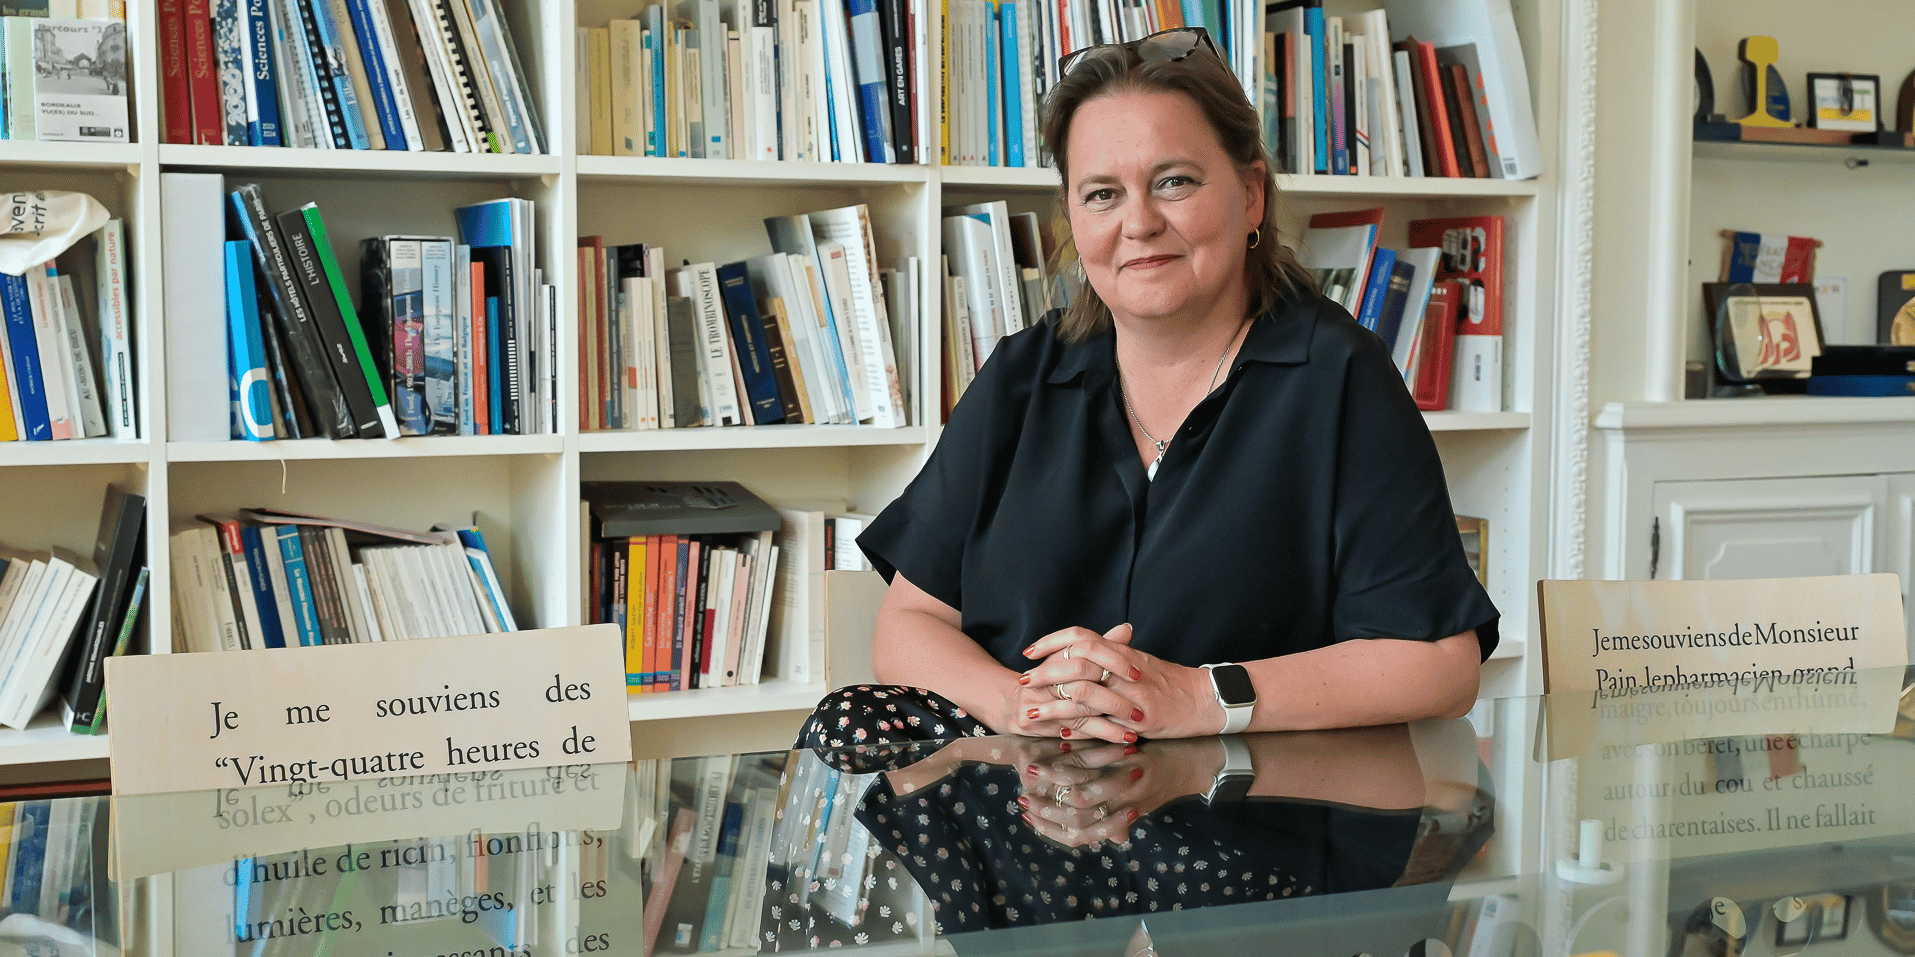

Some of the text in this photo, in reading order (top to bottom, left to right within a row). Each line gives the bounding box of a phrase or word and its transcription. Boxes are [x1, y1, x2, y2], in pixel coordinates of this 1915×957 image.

[167, 16, 180, 77] Sciences
[193, 18, 209, 78] Sciences
[255, 21, 271, 80] Sciences
[894, 46, 904, 74] GARES
[896, 76, 904, 86] EN
[896, 86, 906, 106] ART
[260, 219, 271, 231] DE
[291, 232, 319, 286] L'HISTOIRE
[106, 231, 122, 340] accessibles par nature
[295, 307, 307, 322] LES
[698, 268, 723, 358] LE TROMBINOSCOPE
[210, 673, 592, 738] Je me souviens des
[446, 734, 540, 767] heures
[562, 726, 596, 756] de
[326, 785, 423, 818] odeurs
[432, 776, 466, 806] de
[574, 771, 600, 792] et
[1680, 772, 1706, 795] du
[1715, 778, 1754, 794] cou
[1762, 774, 1782, 790] et
[1792, 764, 1875, 790] chaussé
[1604, 803, 1876, 842] de charentaises. Il ne fallait
[336, 844, 371, 874] de
[380, 836, 456, 869] ricin,
[225, 872, 607, 945] lumières, manèges, et les
[565, 925, 610, 956] des
